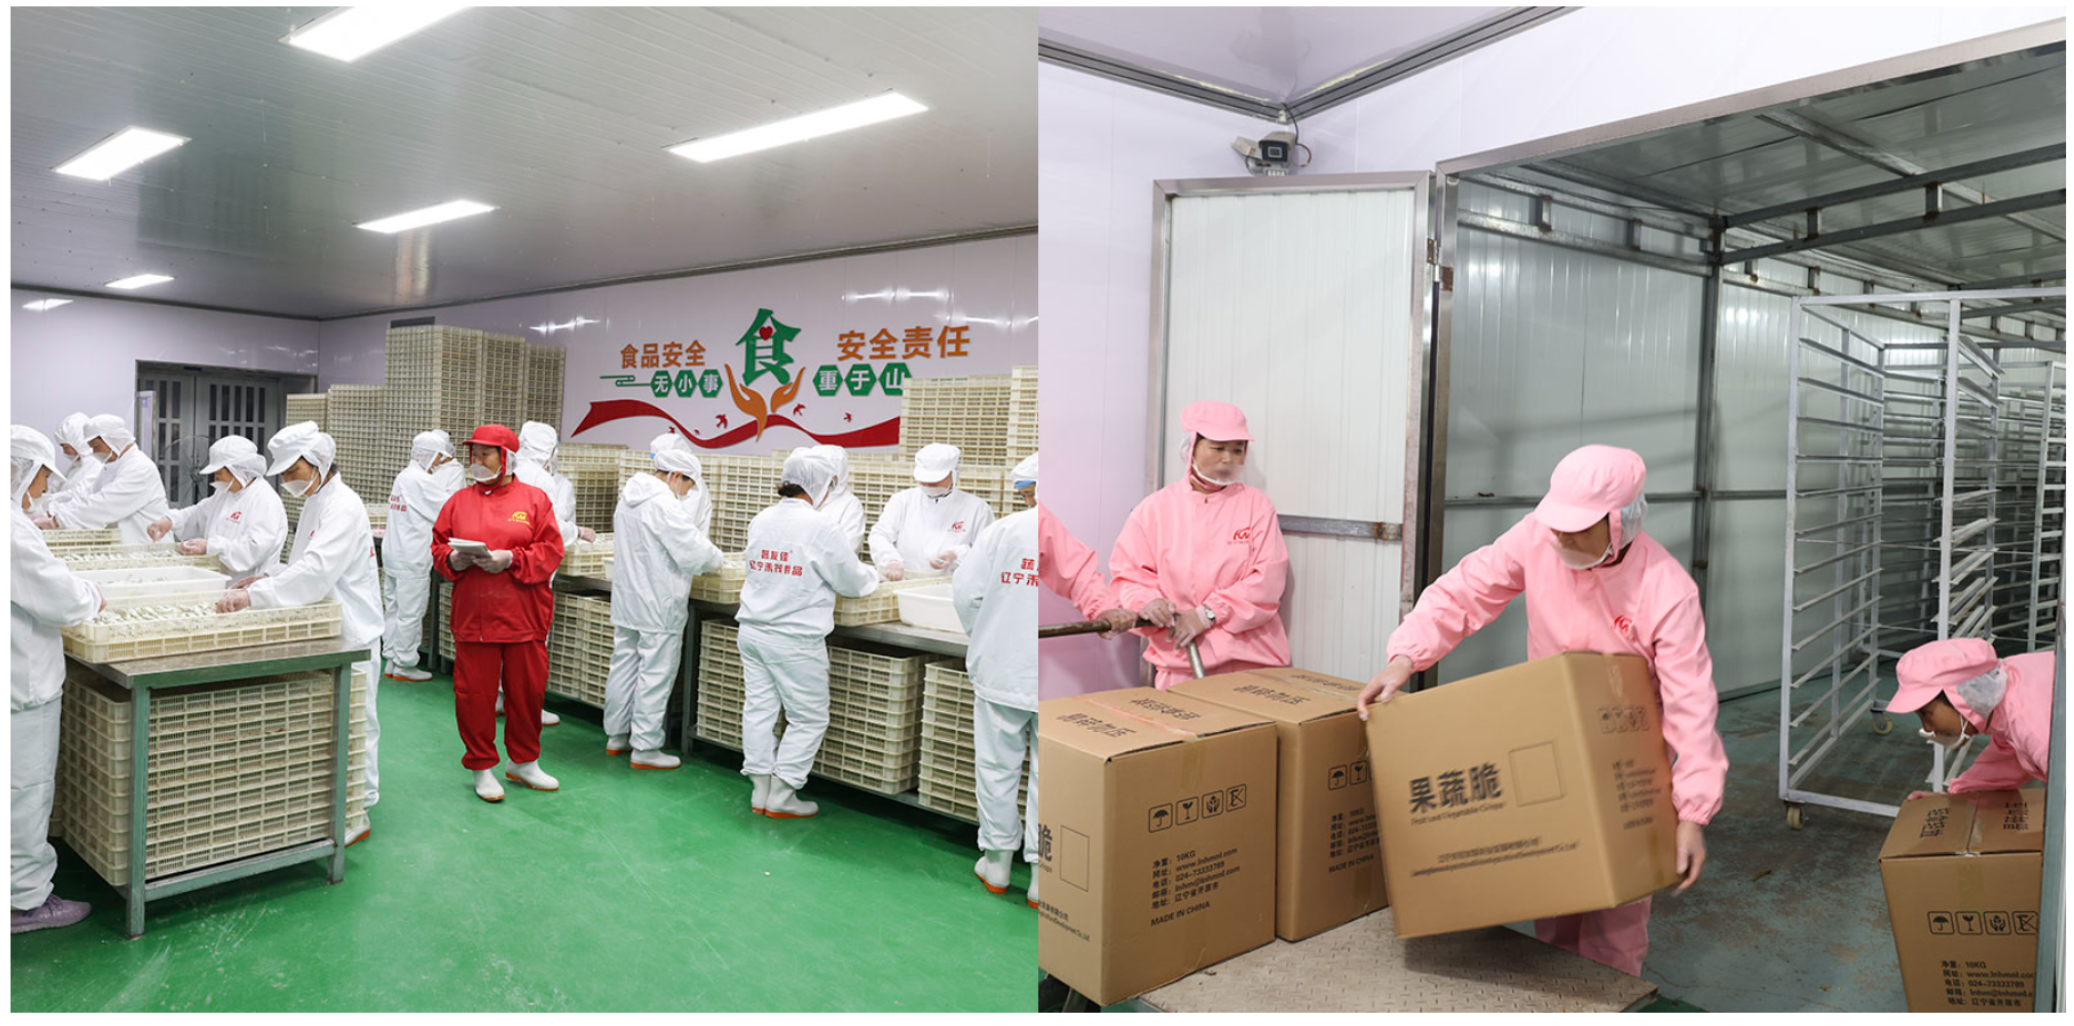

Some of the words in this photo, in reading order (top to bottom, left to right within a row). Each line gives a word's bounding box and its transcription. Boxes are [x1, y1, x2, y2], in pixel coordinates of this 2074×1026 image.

[620, 340, 706, 369] 食品安全
[735, 308, 802, 387] 食
[837, 325, 970, 361] 安全责任
[653, 373, 719, 393] 无小事
[819, 368, 905, 391] 重于山
[1020, 558, 1038, 571] 蔬
[1409, 762, 1503, 814] 果蔬脆
[1150, 912, 1174, 926] MADE
[1176, 909, 1185, 918] IN
[1186, 901, 1211, 914] CHINA
